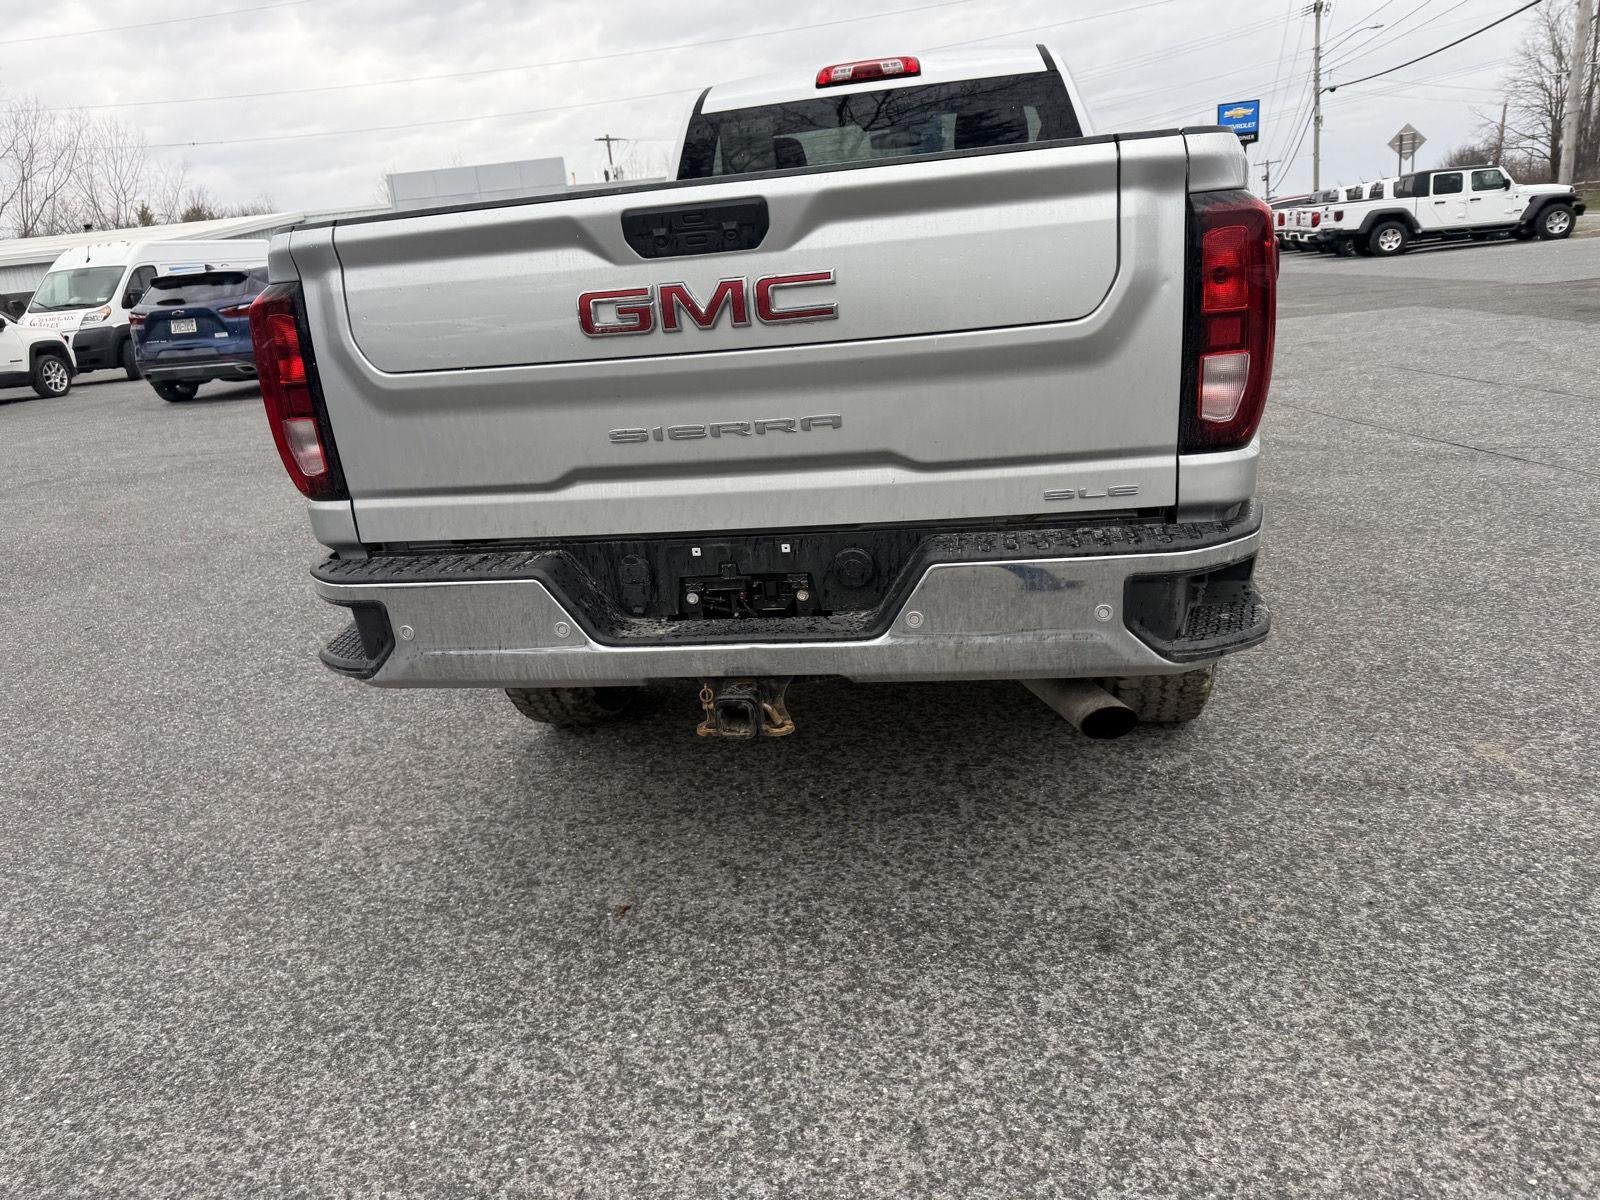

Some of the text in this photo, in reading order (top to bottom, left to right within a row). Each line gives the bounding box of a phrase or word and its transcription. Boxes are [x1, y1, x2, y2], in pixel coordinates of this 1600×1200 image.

[577, 267, 839, 339] GMC
[608, 413, 843, 443] SIERRA
[1043, 484, 1139, 501] SLE
